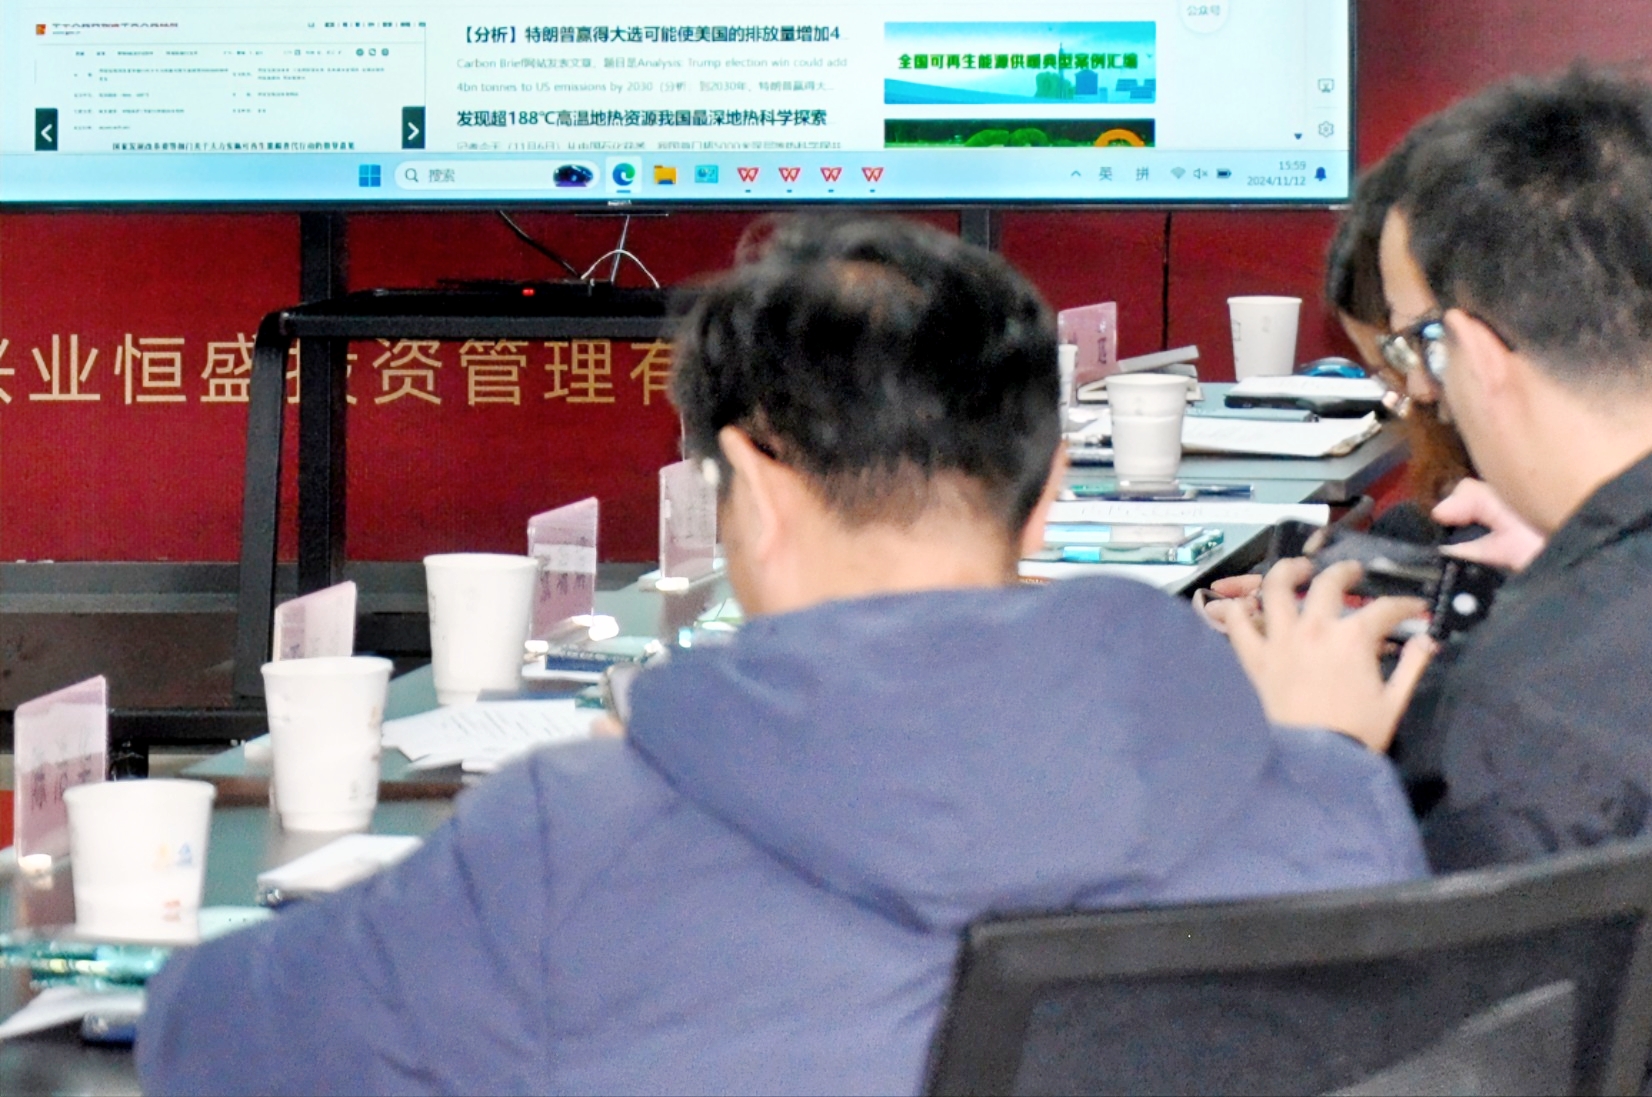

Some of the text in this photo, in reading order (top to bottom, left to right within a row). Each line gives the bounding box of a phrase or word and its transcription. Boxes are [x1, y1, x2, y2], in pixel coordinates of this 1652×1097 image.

[1187, 5, 1220, 16] 公众号
[457, 59, 496, 68] Carbon
[688, 58, 721, 69] Trump
[725, 58, 768, 67] election
[772, 59, 789, 67] win
[794, 58, 823, 67] could
[827, 58, 847, 67] add
[898, 53, 1138, 71] 全国可再生能源供暖典型案例汇编
[457, 83, 477, 92] 4bn
[481, 84, 517, 92] tonnes
[521, 83, 532, 92] to
[536, 82, 550, 92] US
[610, 82, 623, 94] by
[1280, 161, 1306, 170] 15:59
[429, 168, 455, 182] 搜索
[1099, 167, 1149, 181] 英 拼
[1247, 176, 1306, 186] 2024/11/12
[0, 332, 672, 406] 业恒盛资管理有
